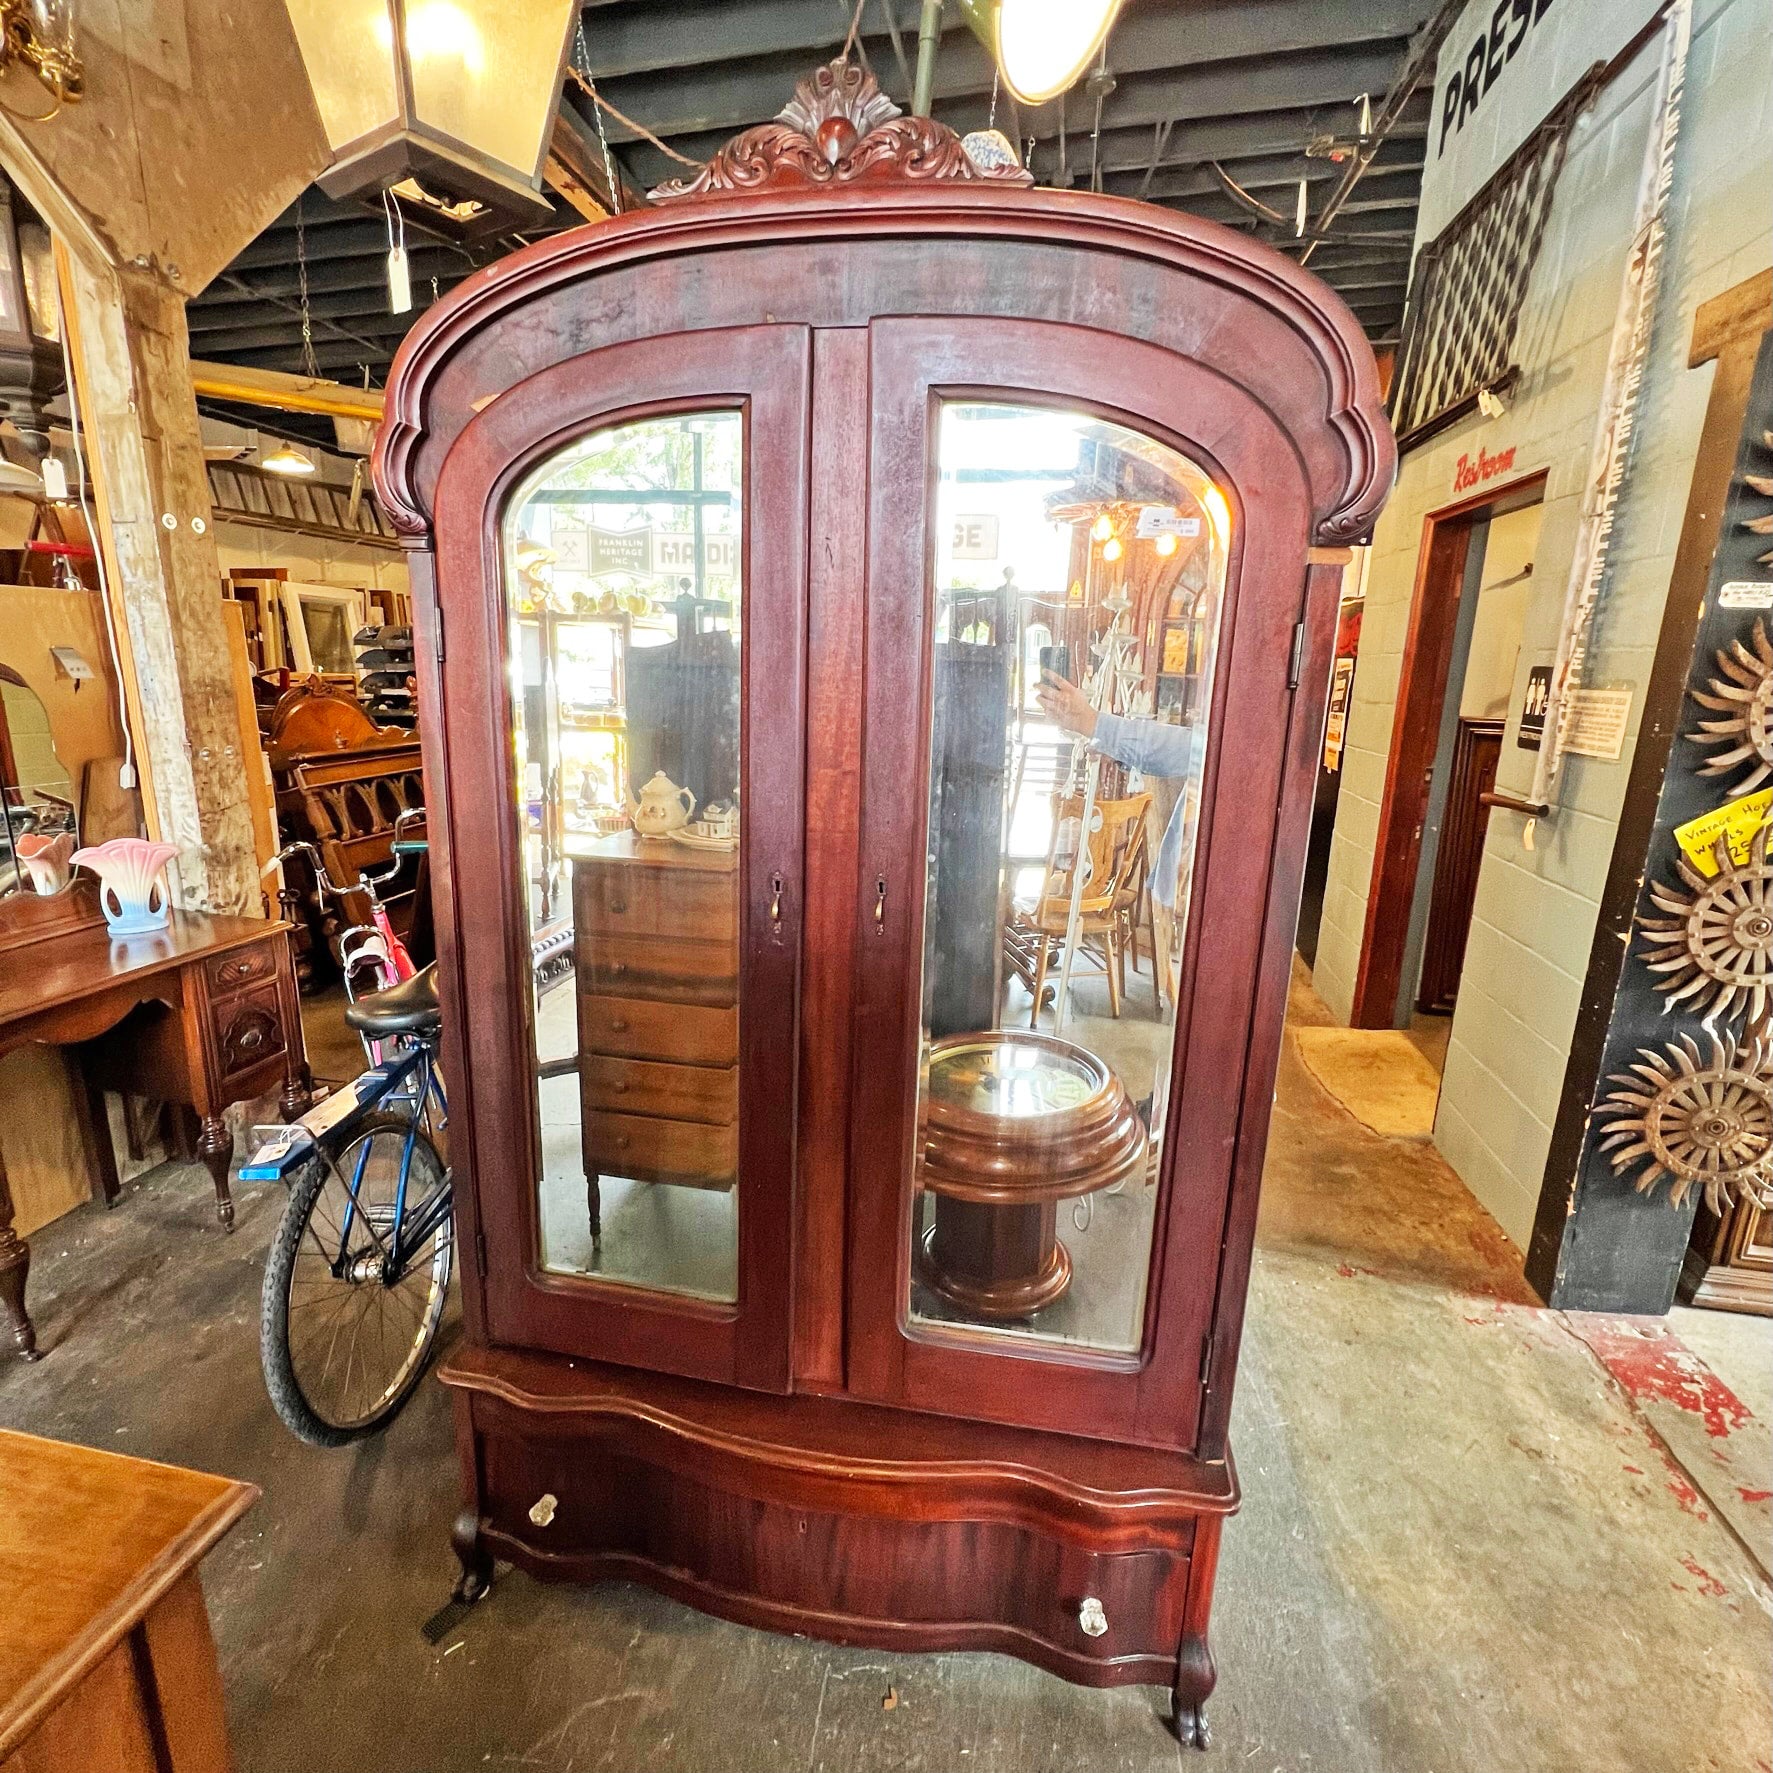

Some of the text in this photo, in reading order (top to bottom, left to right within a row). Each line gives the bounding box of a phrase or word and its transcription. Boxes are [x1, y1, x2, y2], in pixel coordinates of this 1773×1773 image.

[598, 538, 644, 547] FRANKLIN
[599, 549, 644, 557] HERITAGE
[1685, 816, 1733, 840] VINTAGE
[1694, 829, 1743, 855] WHLS
